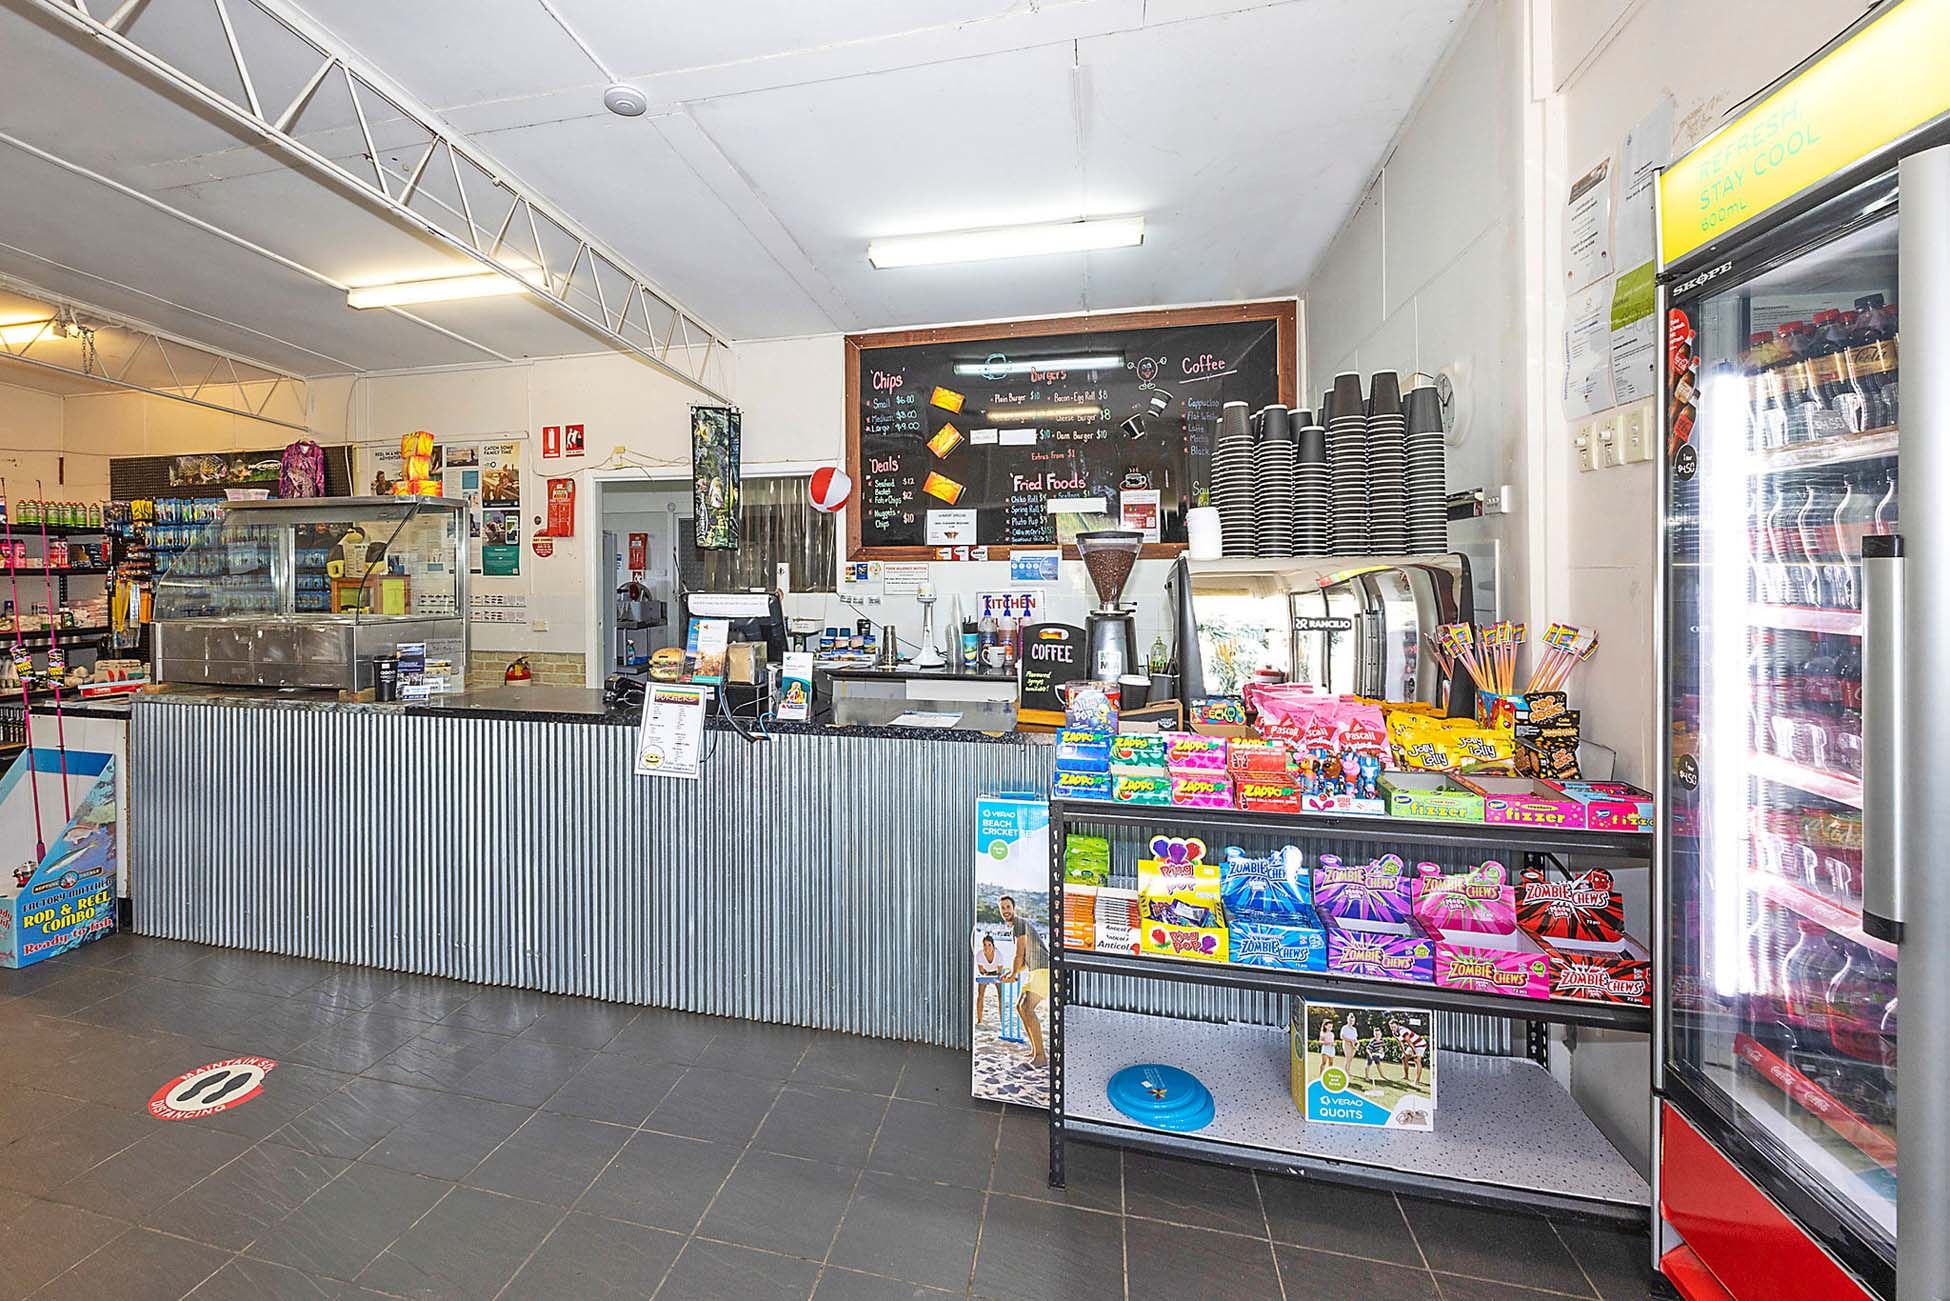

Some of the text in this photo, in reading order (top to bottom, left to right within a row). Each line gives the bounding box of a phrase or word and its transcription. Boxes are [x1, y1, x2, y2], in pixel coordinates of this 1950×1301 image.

[1700, 100, 1798, 180] REFRESH
[1700, 167, 1745, 210] STAY
[1753, 123, 1822, 176] COOL
[1673, 261, 1732, 297] SKOPE
[1182, 354, 1226, 374] Coffee
[1030, 367, 1067, 385] Burgers
[1008, 393, 1026, 404] Burger
[1084, 390, 1096, 400] Roll
[1098, 390, 1108, 400] $8
[873, 398, 890, 409] Small
[1100, 408, 1111, 420] $8
[871, 424, 890, 435] Large
[1073, 430, 1094, 442] Burger
[1096, 429, 1108, 440] $10
[1191, 445, 1210, 456] Black
[902, 477, 915, 486] $12
[902, 491, 913, 500] $12
[1027, 494, 1039, 503] Roll
[874, 507, 896, 520] Nuggets
[1011, 504, 1040, 516] Spring Roll
[903, 512, 915, 524] $10
[985, 598, 1036, 609] KITCHEN
[1031, 643, 1073, 663] COFFEE
[1529, 696, 1555, 711] POP
[1202, 706, 1236, 723] GECKO
[1529, 703, 1566, 723] ROCKS
[1062, 731, 1094, 743] ZAPPO
[1270, 725, 1299, 737] Pascall
[1306, 727, 1328, 737] scall
[1345, 732, 1376, 742] Pascall
[1115, 738, 1148, 748] ZAPPO
[1175, 740, 1209, 751] ZAPPO
[1231, 738, 1266, 748] ZAPPO
[1408, 743, 1434, 756] Jolly
[1458, 737, 1483, 749] Jolly
[1469, 745, 1496, 758] Lolly
[1552, 749, 1567, 760] POP
[1421, 753, 1448, 767] Lolly
[1554, 753, 1574, 769] ROCKS
[1059, 773, 1094, 786] ZAPPO
[1120, 780, 1154, 792] ZAPPO
[1178, 780, 1214, 793] ZAPPO
[1244, 785, 1281, 797] ZAPPO
[1410, 801, 1468, 818] fizzer
[1505, 807, 1565, 823] fizzer
[983, 819, 1012, 828] BEACH
[983, 828, 1018, 837] CRICKET
[1160, 864, 1194, 877] Ring
[1229, 861, 1286, 879] ZOMBIE CHE
[1326, 868, 1397, 890] ZOMBIE CHEWS
[1422, 877, 1500, 899] ZOMBIE CHEWS
[23, 879, 112, 912] FACTORY MATCHED
[1526, 884, 1608, 906] ZOMBIE CHEWS
[23, 890, 111, 928] ROD & REEL
[42, 908, 95, 934] COMBO
[24, 917, 113, 955] Ready to fish
[1169, 930, 1199, 943] Ring
[1097, 940, 1130, 950] Anticol
[1241, 940, 1308, 959] ZOMBIE CHEWS
[1343, 948, 1413, 969] ZOMBIE CHEWS
[1450, 962, 1527, 986] ZOMBIE CHEWS
[1560, 970, 1643, 995] ZOMBIE CHEWS
[180, 1058, 259, 1081] MAINTAIN
[151, 1099, 227, 1119] DISTANCING
[1331, 1098, 1364, 1107] VERAO
[1320, 1107, 1363, 1119] QUOITS
